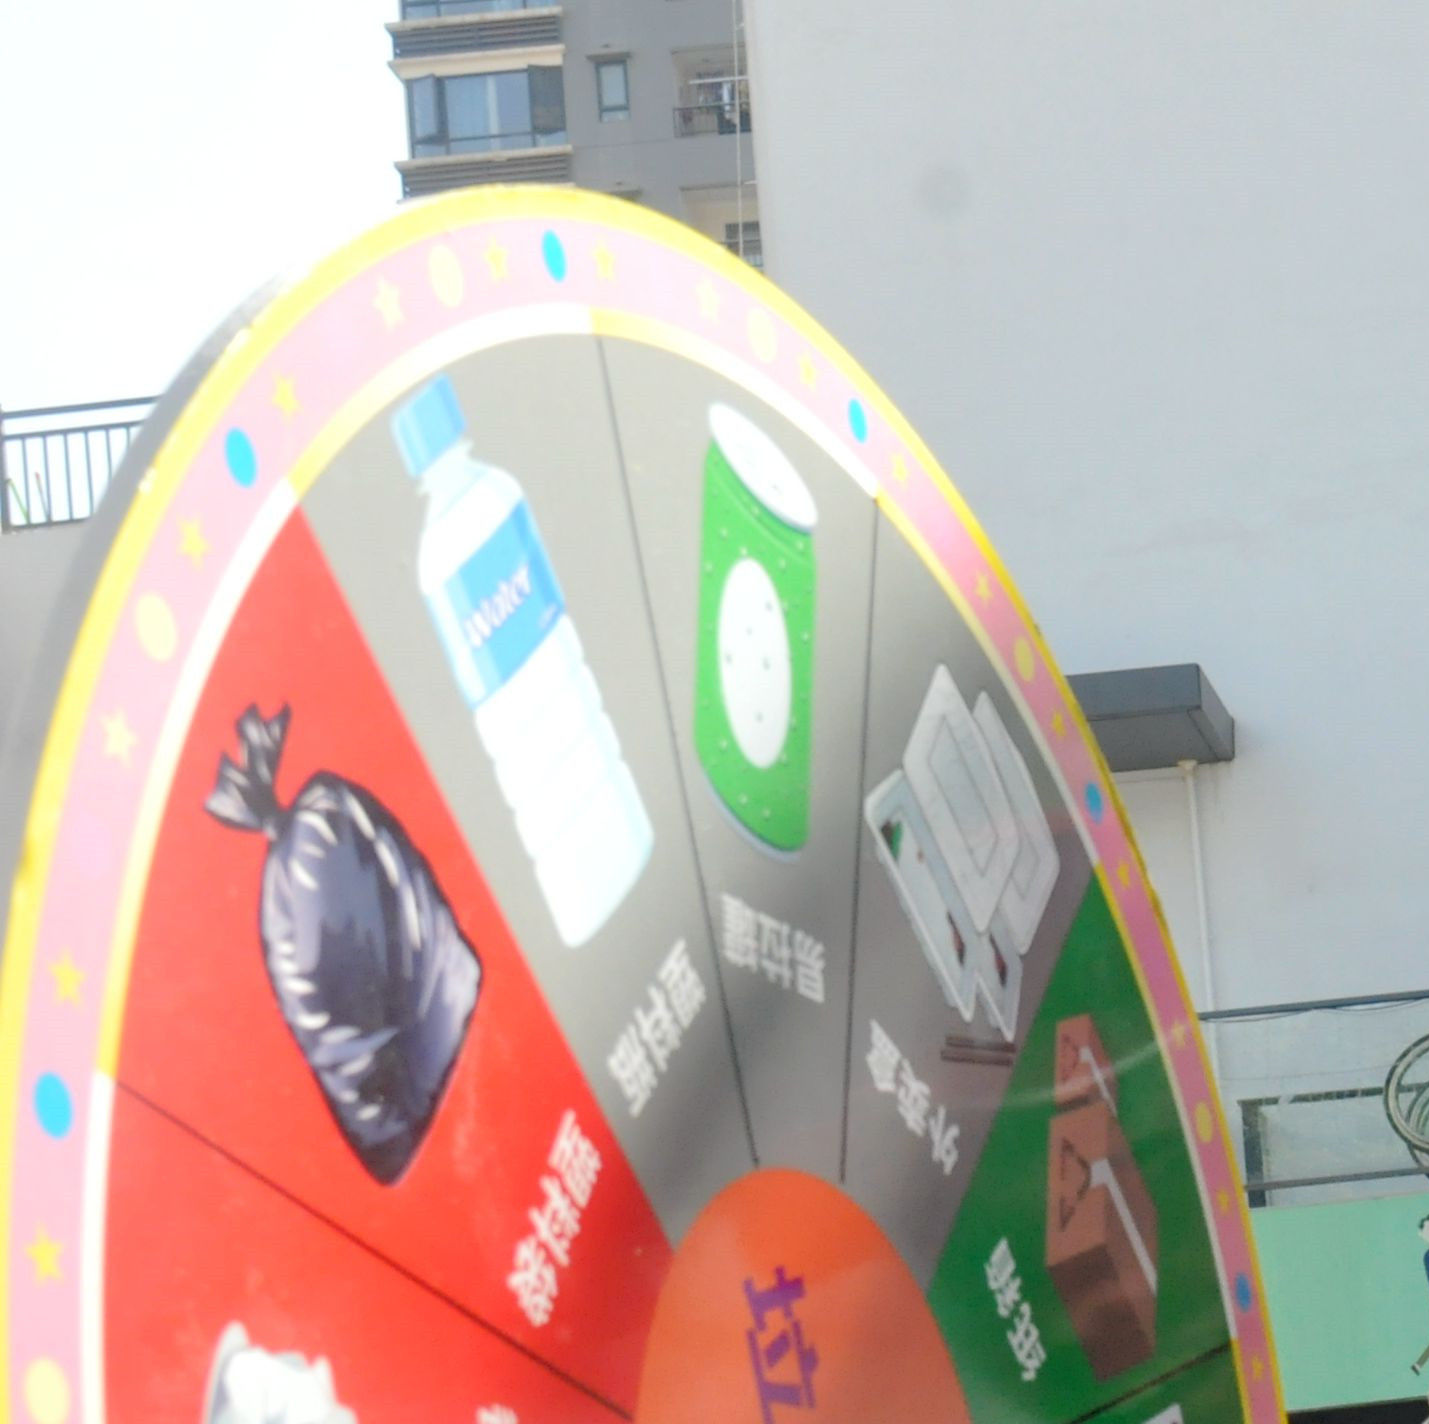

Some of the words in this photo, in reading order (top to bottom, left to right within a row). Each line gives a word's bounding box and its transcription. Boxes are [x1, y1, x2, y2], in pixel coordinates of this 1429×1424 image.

[721, 892, 826, 1003] 易拉罐
[608, 938, 706, 1117] 塑料瓶
[865, 1019, 960, 1175] 外卖盒
[506, 1110, 602, 1328] 塑料袋
[985, 1237, 1046, 1381] 纸箱
